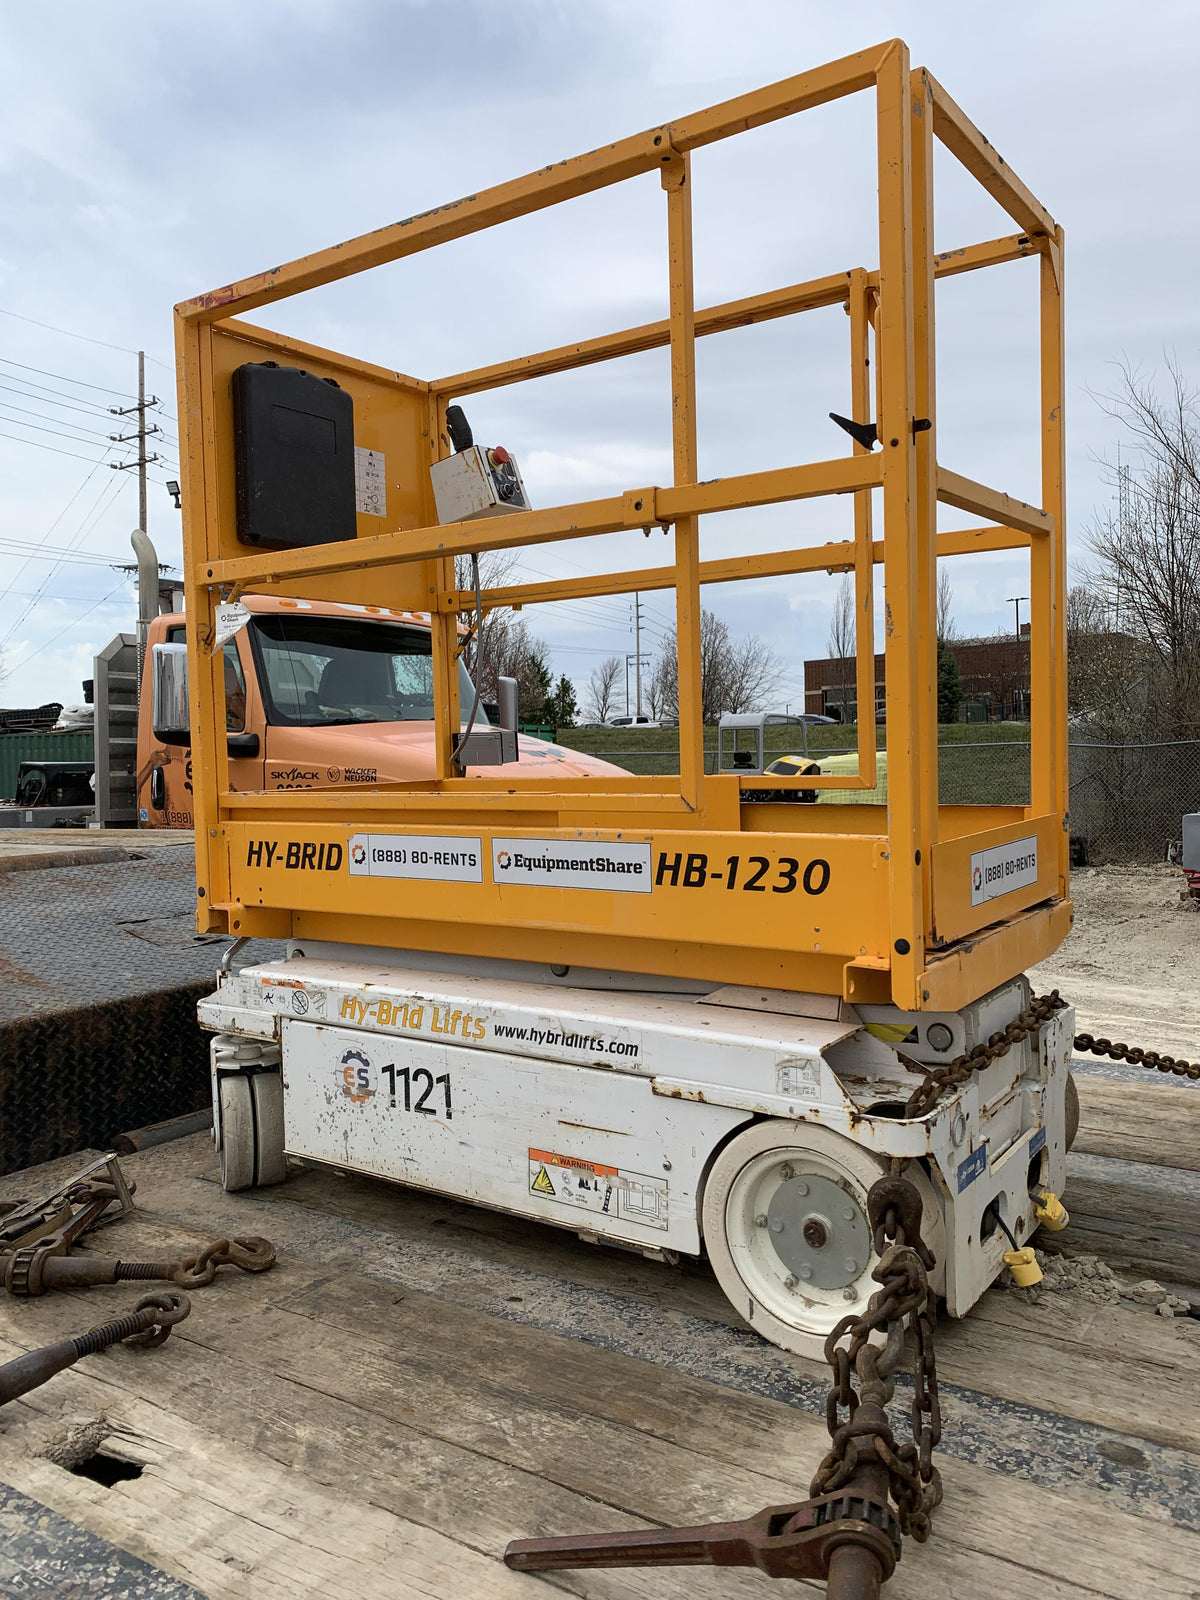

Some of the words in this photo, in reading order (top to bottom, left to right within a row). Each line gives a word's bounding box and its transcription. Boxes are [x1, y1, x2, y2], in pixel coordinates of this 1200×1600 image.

[270, 767, 320, 781] SKYJACK
[344, 767, 377, 775] WACKER
[246, 840, 343, 871] HY-BRID
[372, 848, 406, 864] (888)
[411, 851, 477, 867] 80-RENTS
[514, 853, 643, 875] EquipmentShare
[985, 862, 1004, 884] (888)
[1005, 853, 1036, 876] 80-RENTS
[655, 852, 831, 896] HB-1230
[341, 994, 425, 1030] Hy-Brid
[431, 1006, 487, 1039] Lifts
[493, 1023, 639, 1057] www.hybridlifts.com
[343, 1066, 370, 1089] ES
[381, 1063, 453, 1120] 1121
[559, 1156, 595, 1173] WARNING
